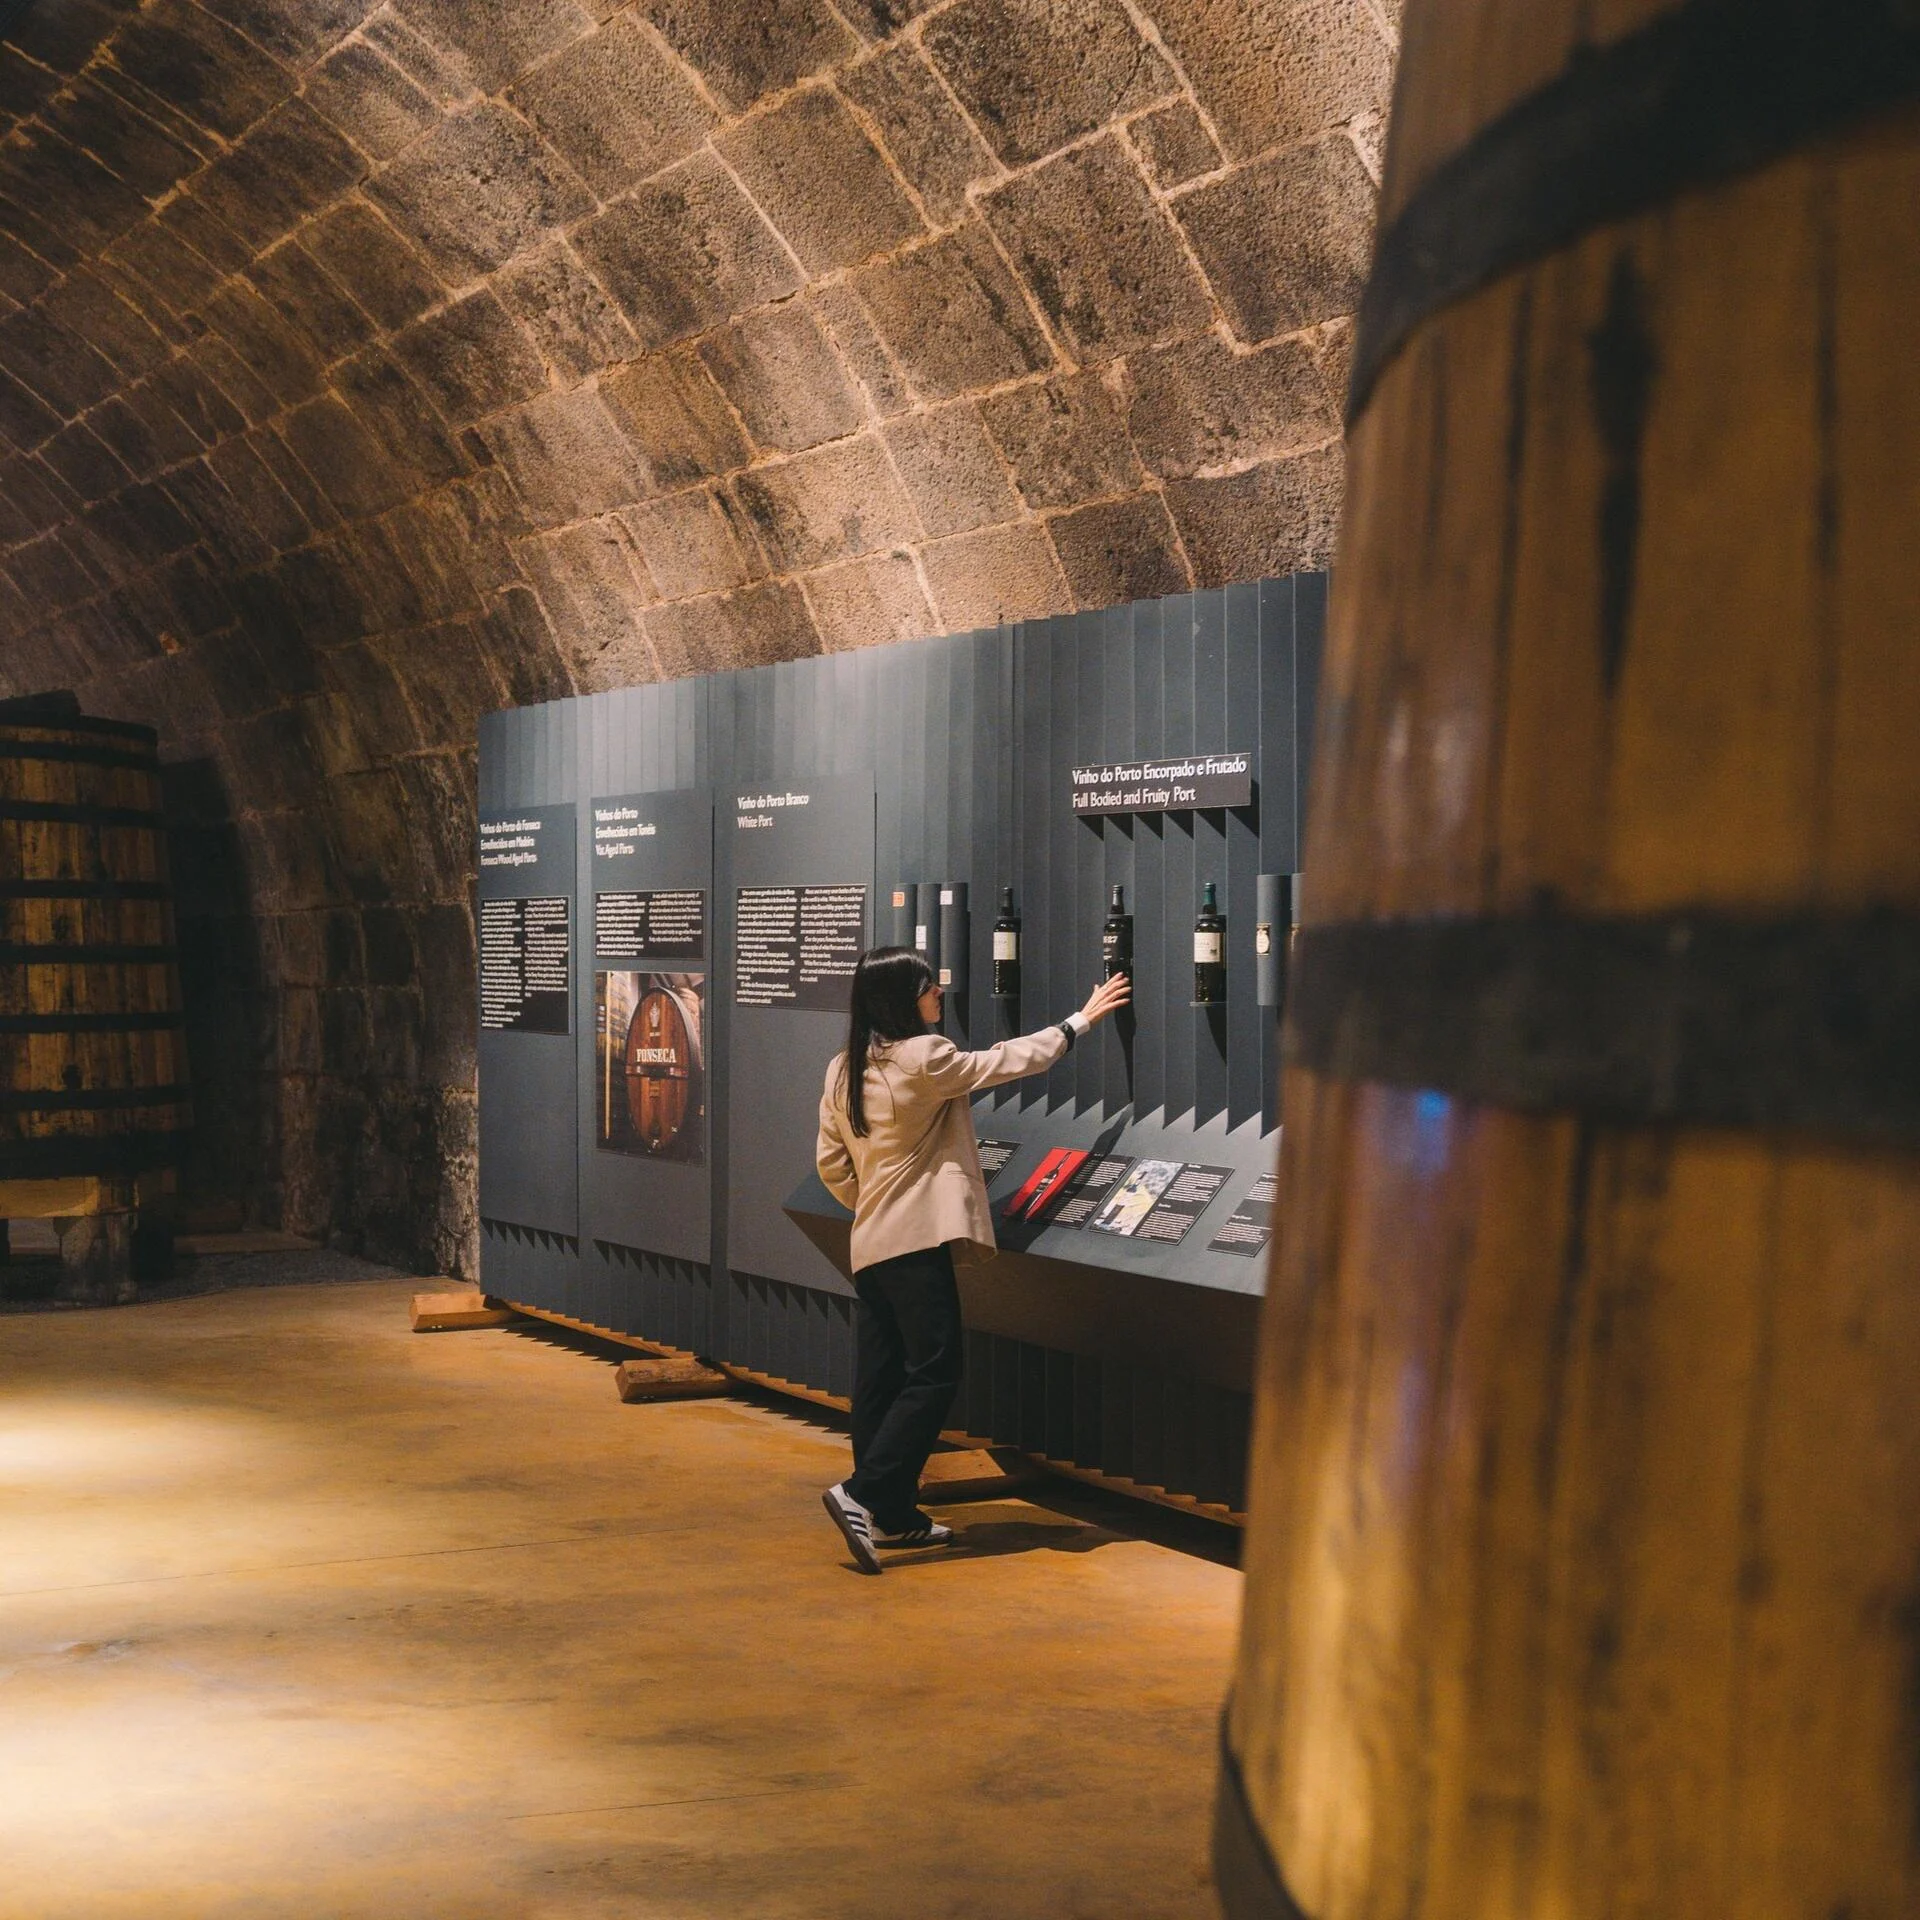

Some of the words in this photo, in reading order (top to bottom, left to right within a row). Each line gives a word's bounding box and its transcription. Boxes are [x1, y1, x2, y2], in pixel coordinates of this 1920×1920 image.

[1072, 769, 1099, 784] Vinho
[1100, 767, 1113, 783] do
[1115, 766, 1142, 782] Porto
[1143, 761, 1195, 782] Encorpado
[1196, 763, 1204, 775] e
[1205, 756, 1247, 775] Frutado
[737, 796, 756, 809] Vinho
[757, 795, 766, 808] do
[766, 794, 785, 807] Porto
[785, 792, 809, 806] Branco
[1072, 792, 1089, 808] Full
[1090, 790, 1122, 807] Bodied
[1123, 789, 1141, 805] and
[1142, 788, 1170, 807] Fruity
[1173, 786, 1196, 802] Port
[613, 808, 621, 820] do
[621, 807, 638, 819] Porto
[737, 815, 757, 829] White
[758, 814, 773, 827] Port
[636, 1048, 677, 1063] FONSECA
